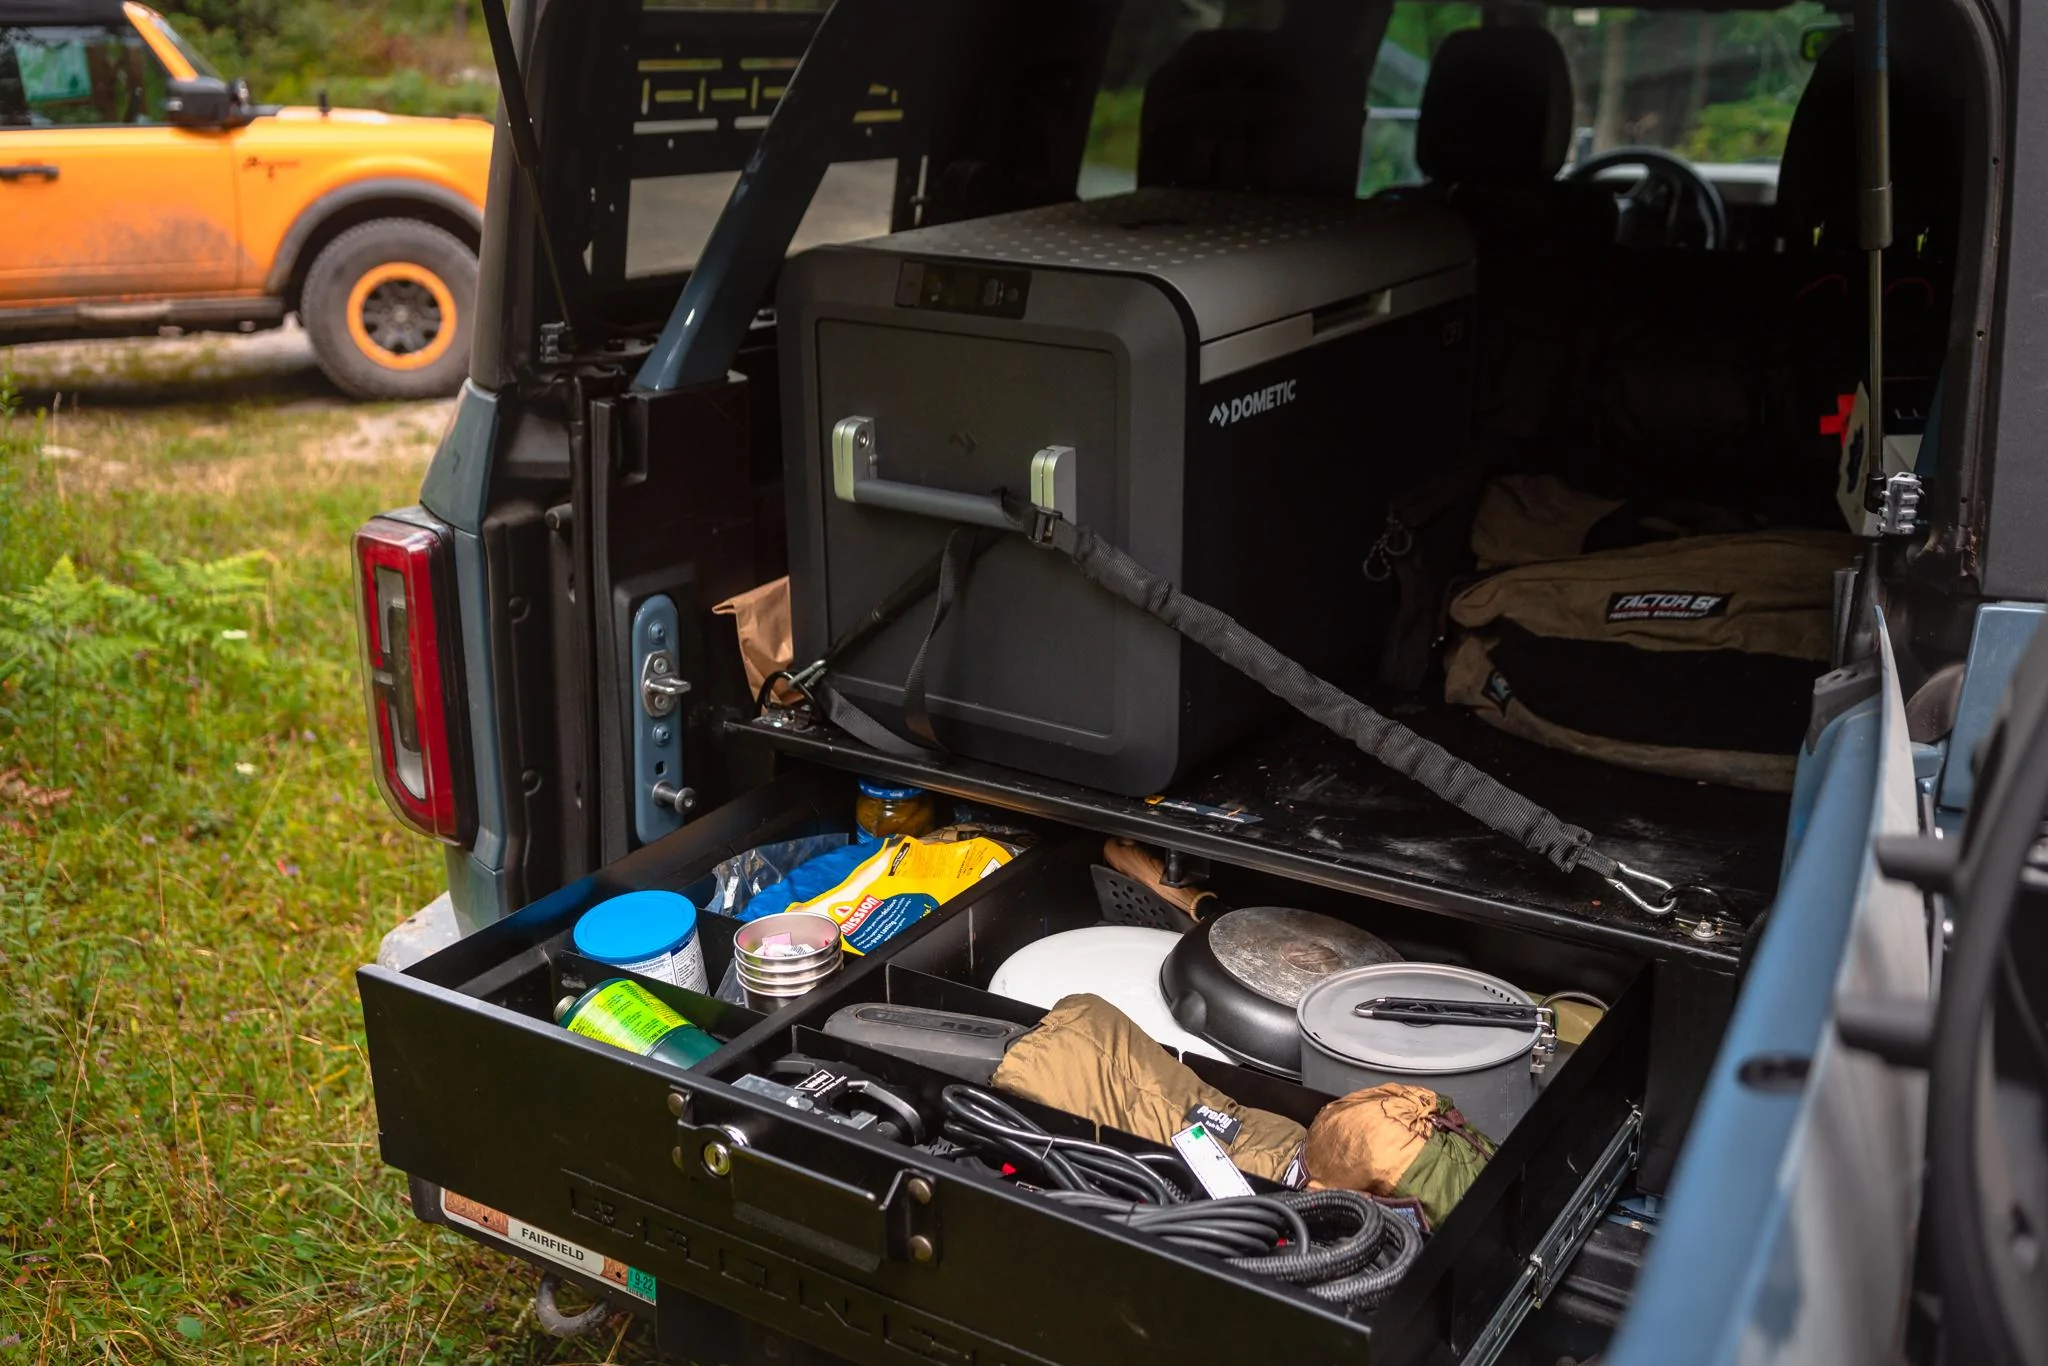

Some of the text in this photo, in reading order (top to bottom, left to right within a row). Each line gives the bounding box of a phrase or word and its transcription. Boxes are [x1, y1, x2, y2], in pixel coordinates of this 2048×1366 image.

[1231, 380, 1297, 423] DOMETIC
[1614, 594, 1690, 610] FACTOR
[841, 896, 880, 933] MISSION
[521, 1227, 585, 1261] FAIRFIELD
[634, 1272, 654, 1293] 9-22
